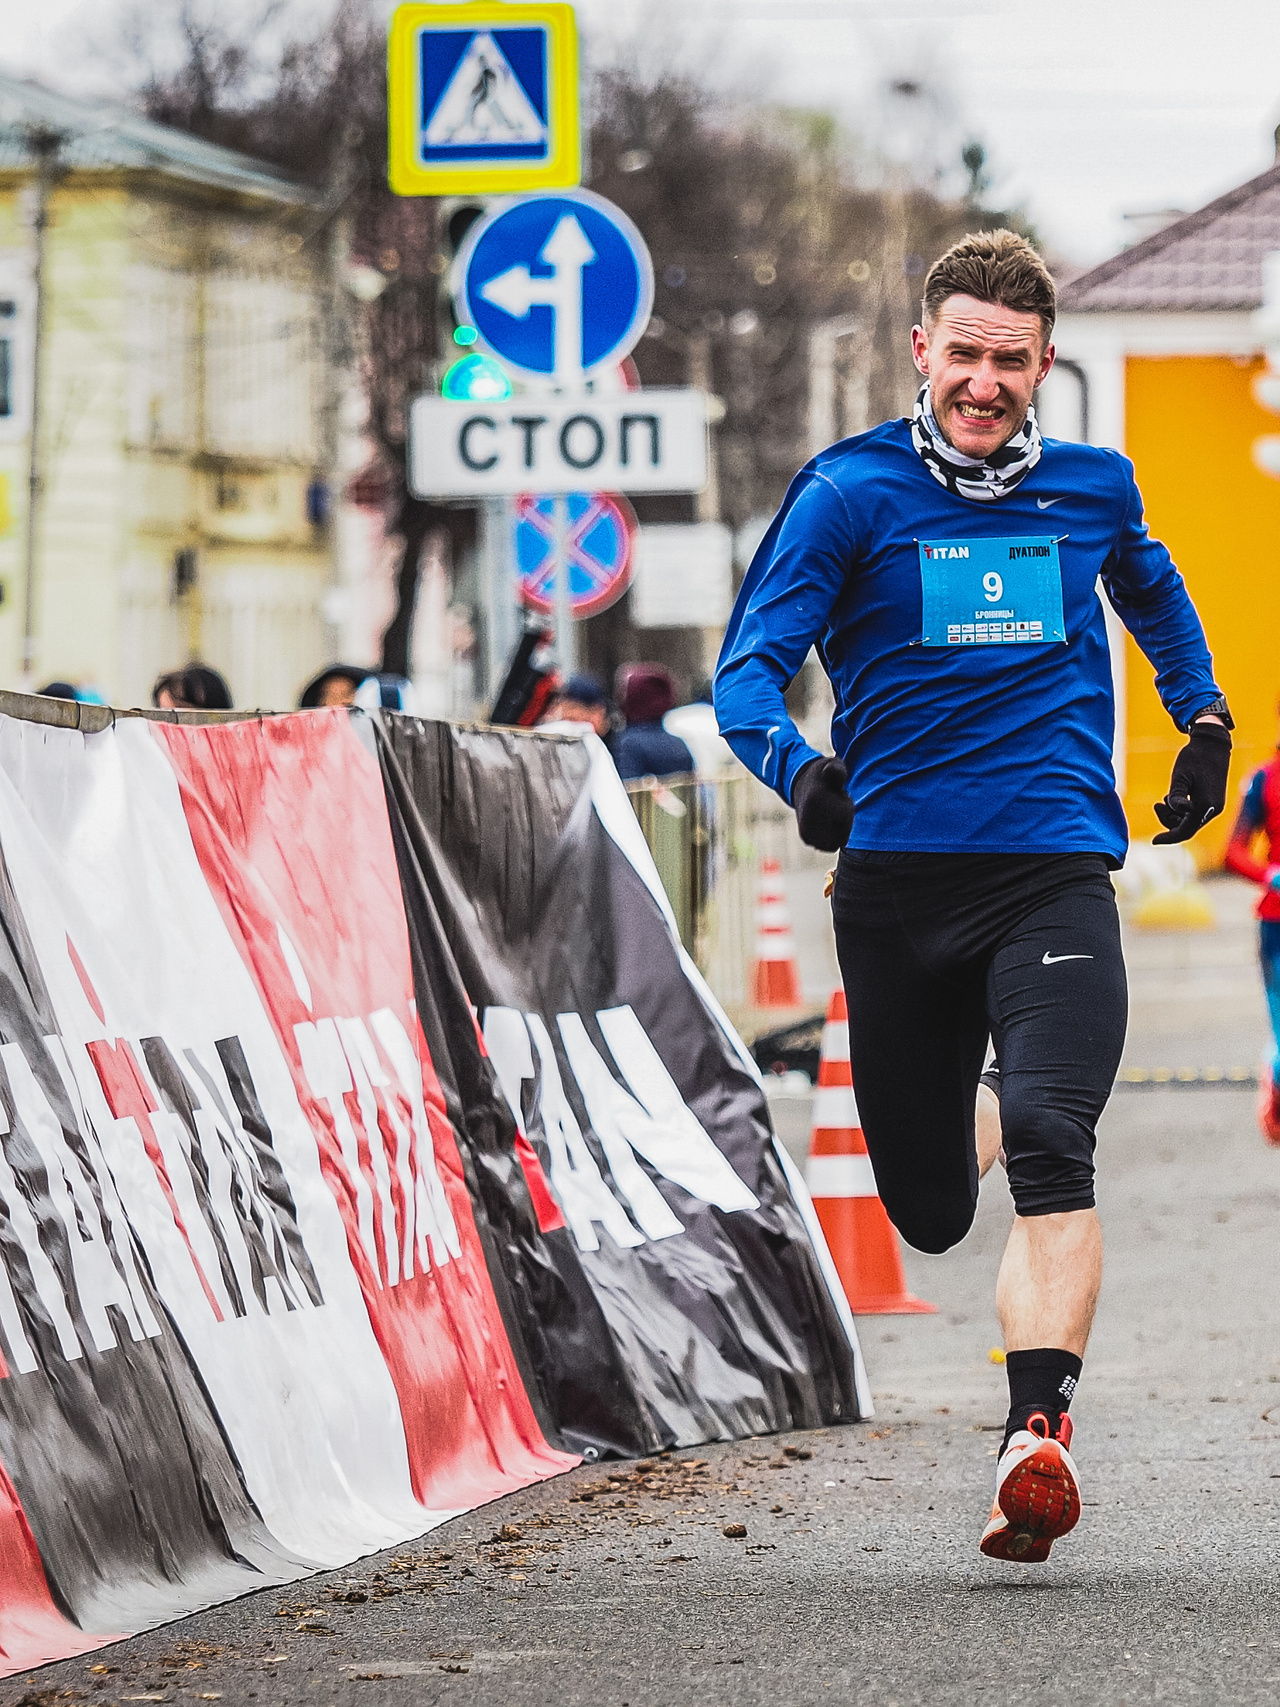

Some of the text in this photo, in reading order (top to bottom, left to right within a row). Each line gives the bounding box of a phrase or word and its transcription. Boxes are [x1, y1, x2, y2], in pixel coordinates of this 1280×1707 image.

[458, 414, 660, 472] СТОП
[923, 545, 970, 560] TITAN
[1009, 545, 1051, 560] ДУАТЛОН
[982, 571, 1004, 602] 9
